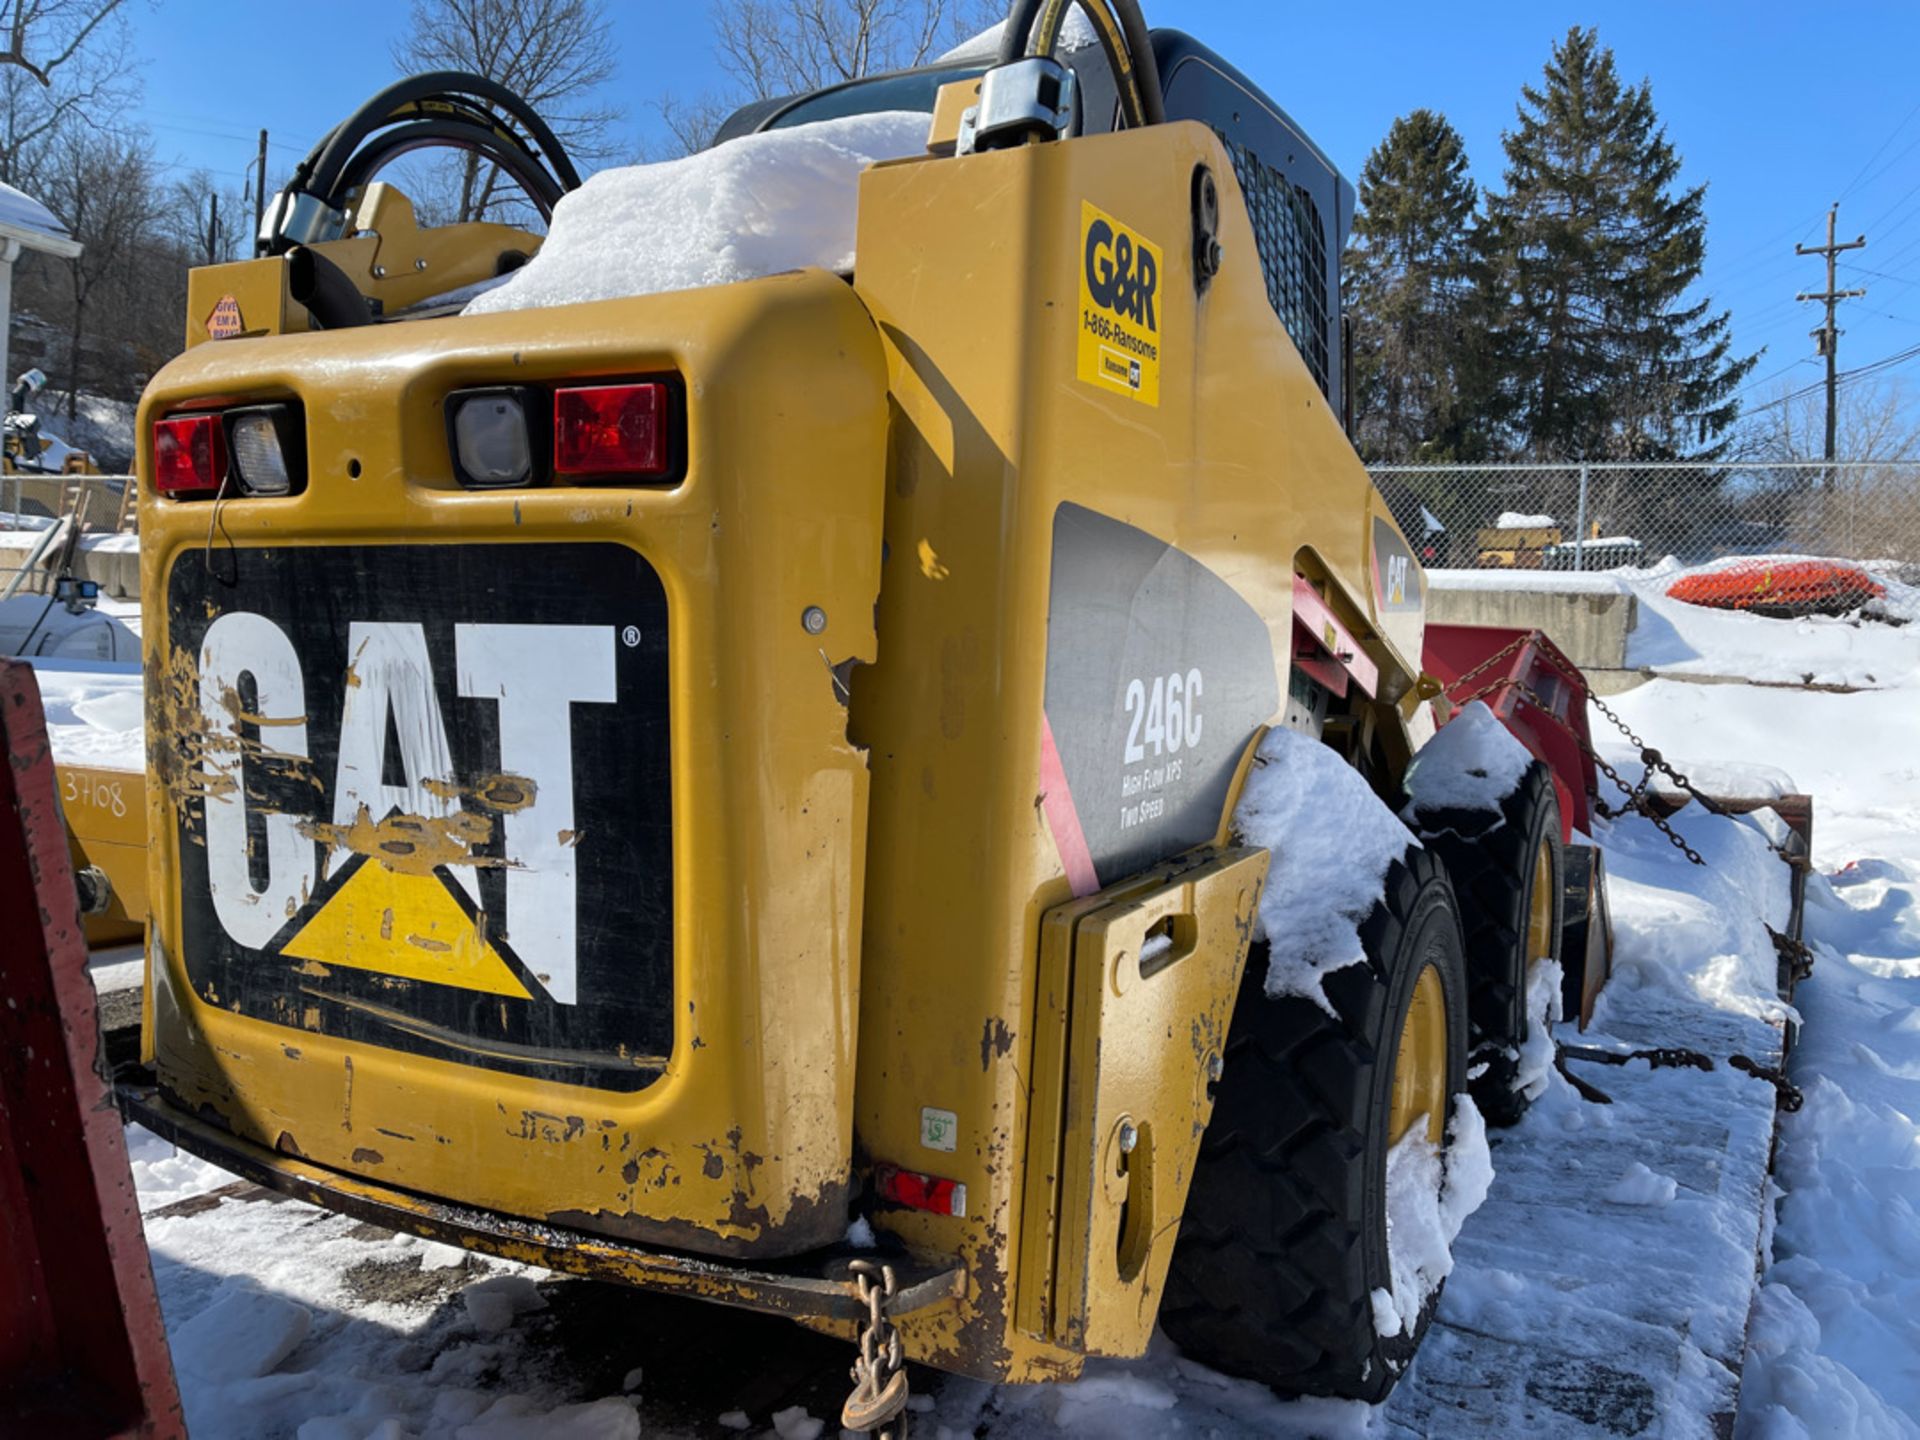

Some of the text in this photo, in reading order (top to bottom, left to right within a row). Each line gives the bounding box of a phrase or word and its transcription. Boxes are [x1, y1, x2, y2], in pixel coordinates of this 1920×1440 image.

[1085, 218, 1158, 333] G&R
[216, 302, 236, 312] GIVE
[231, 316, 237, 326] A
[1084, 309, 1157, 361] 1-866-Ransome
[1387, 554, 1408, 603] CAT
[1124, 667, 1203, 765] 246C
[199, 611, 617, 1006] CAT
